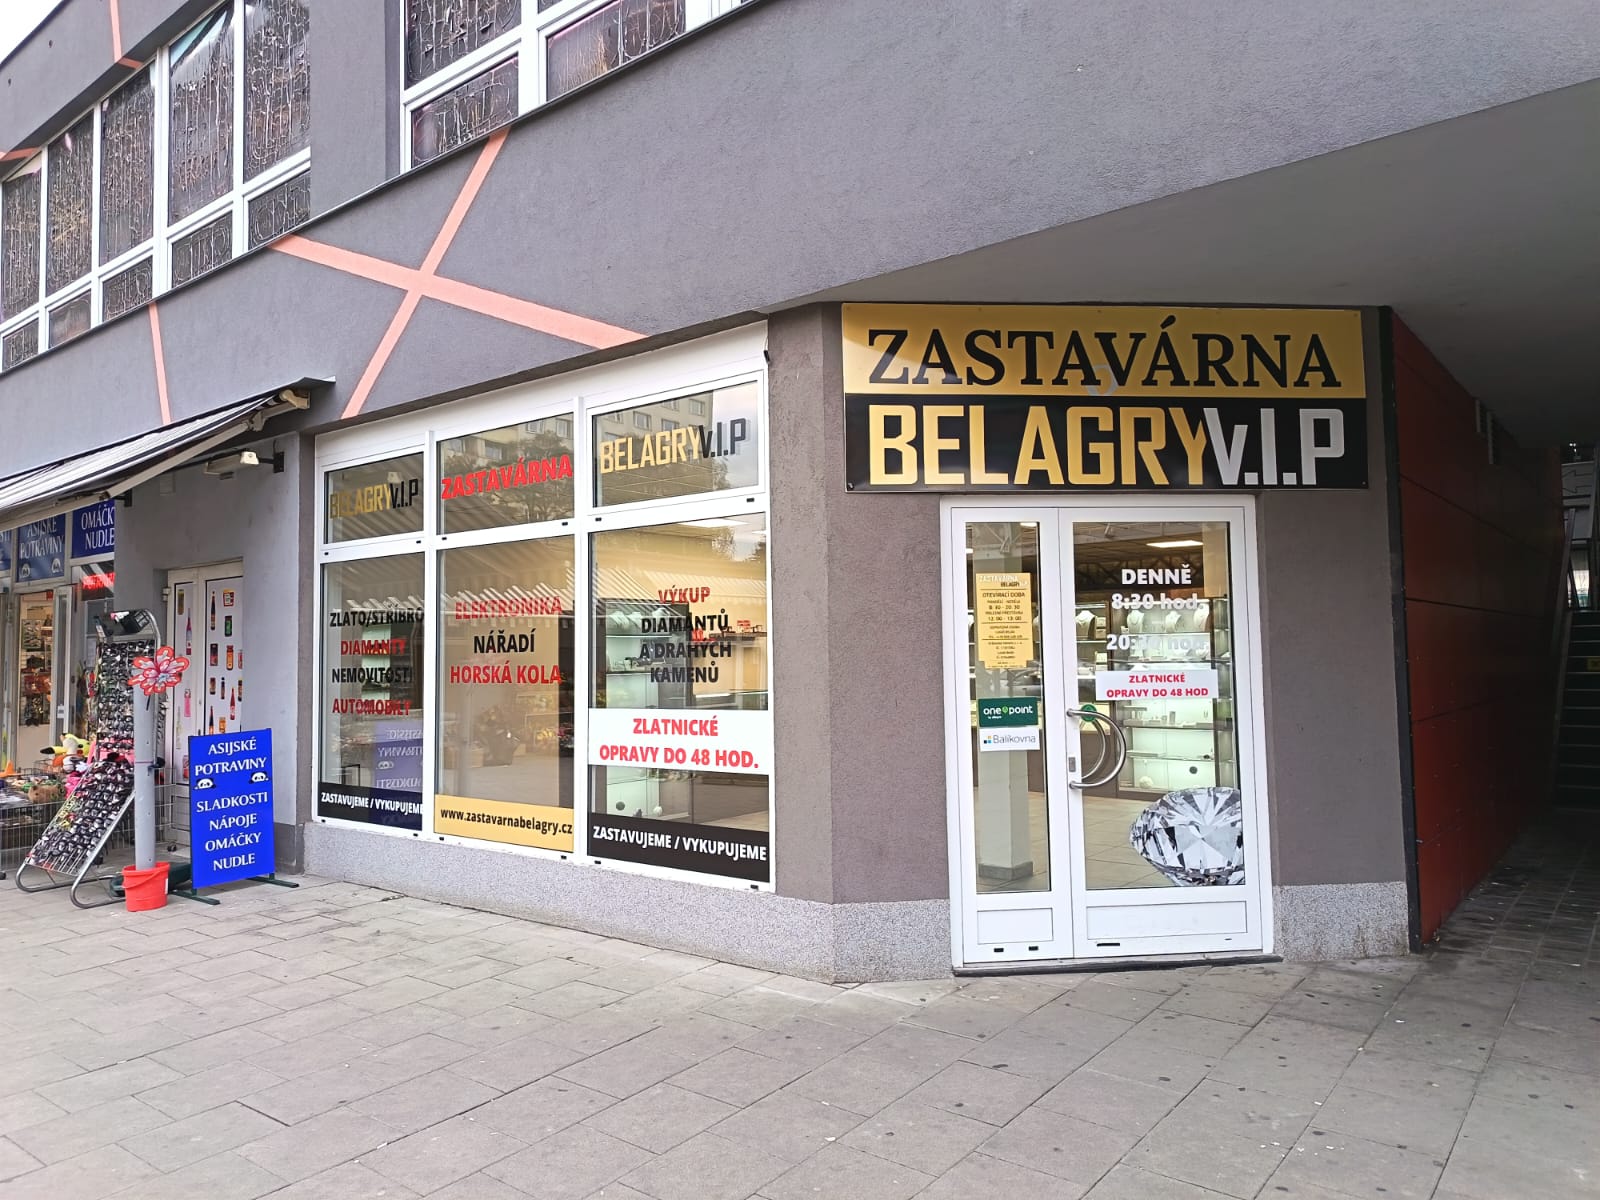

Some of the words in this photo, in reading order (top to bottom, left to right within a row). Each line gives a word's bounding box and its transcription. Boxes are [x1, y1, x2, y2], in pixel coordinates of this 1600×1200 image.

[868, 315, 1341, 388] ZASTAVÁRNA
[868, 403, 1207, 486] BELAGRY
[441, 454, 573, 500] ZASTAVÁRNA
[81, 503, 115, 530] OMÁČK
[20, 535, 65, 560] POTRAVINY
[85, 527, 115, 551] NUDLE
[1121, 564, 1192, 585] DENNĚ
[658, 585, 711, 604] VÝKUP
[1111, 593, 1154, 610] 8:30
[455, 596, 563, 620] ELEKTRONIKA
[641, 608, 729, 633] DIAMANTŮ
[340, 638, 407, 656] DIAMANTY
[473, 628, 537, 654] NÁŘADÍ
[332, 667, 413, 684] NEMOVITOSTI
[450, 660, 513, 684] HORSKÁ
[517, 665, 563, 685] KOLA
[650, 661, 719, 683] KAMENŮ
[1129, 672, 1185, 684] ZLATNICKÉ
[1106, 689, 1149, 698] OPRAVY
[1152, 688, 1168, 698] DO
[1170, 688, 1183, 697] 48
[1185, 688, 1209, 697] HOD
[332, 699, 413, 716] AUTOMOBILY
[633, 715, 719, 737] ZLATNICKÉ
[208, 736, 257, 756] ASIJSKÉ
[599, 745, 659, 763] OPRAVY
[663, 748, 687, 765] DO
[690, 749, 711, 766] 48
[715, 750, 759, 769] HOD.
[194, 757, 267, 777] POTRAVINY
[196, 791, 268, 813] SLADKOSTI
[321, 792, 369, 809] ZASTAVUJEME
[374, 798, 424, 816] VYKUPUJEME
[209, 813, 258, 831] NÁPOJE
[440, 808, 573, 836] www.zastavarnabelagry.cz
[205, 832, 262, 852] OMÁČKY
[593, 826, 672, 849] ZASTAVUJEME
[682, 836, 768, 862] VYKUPUJEME
[213, 853, 256, 871] NUDLE
